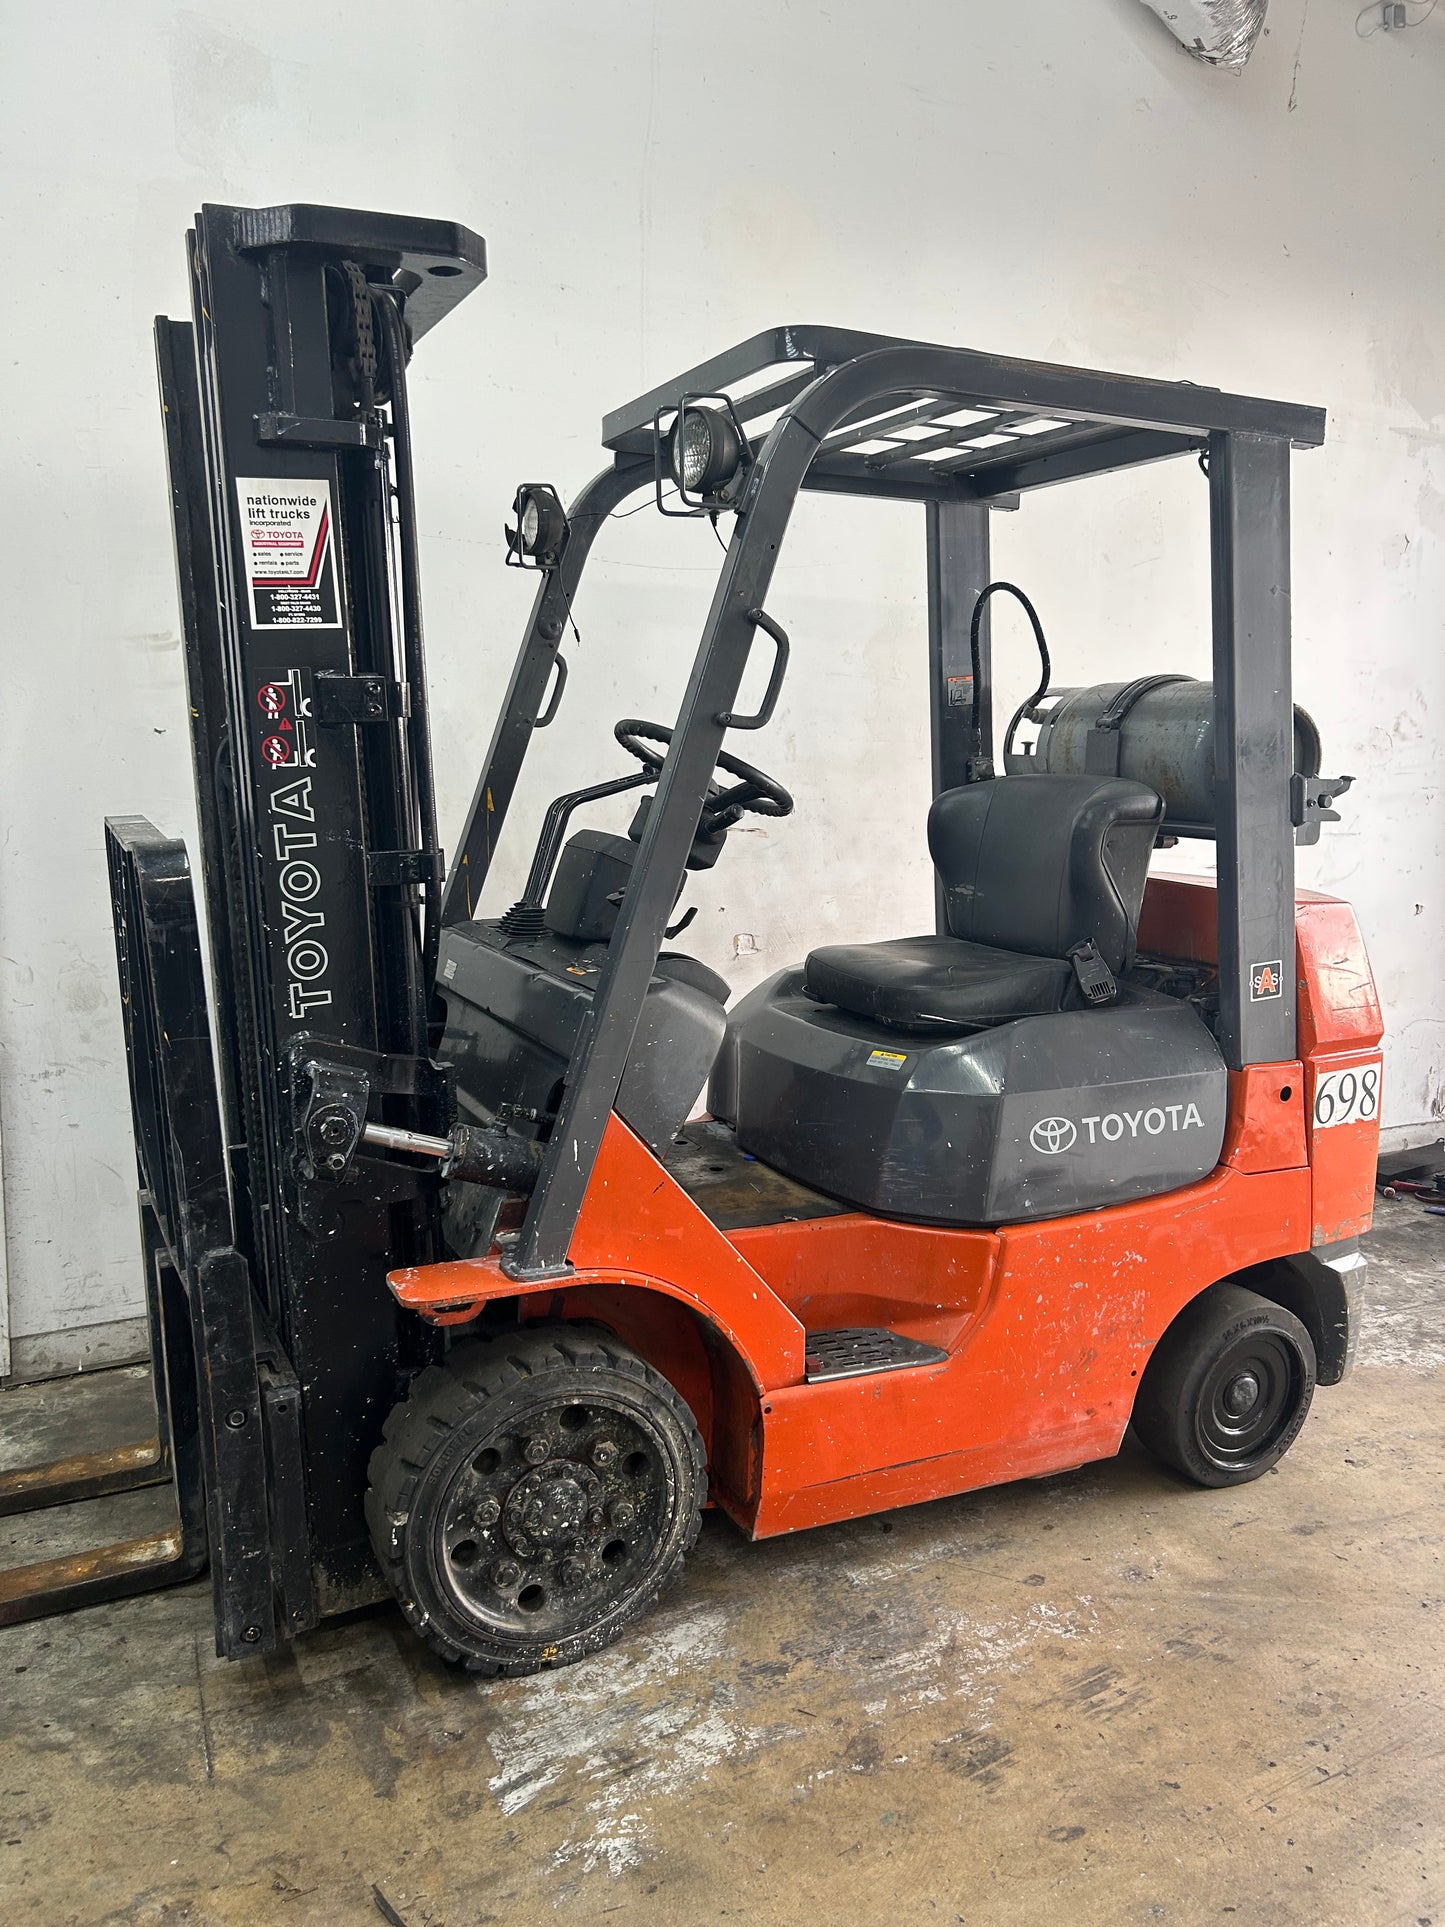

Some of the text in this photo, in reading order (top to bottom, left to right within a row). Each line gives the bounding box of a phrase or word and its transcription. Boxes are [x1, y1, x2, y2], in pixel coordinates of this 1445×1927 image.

[246, 494, 317, 506] nationwide
[247, 507, 311, 519] lift trucks
[267, 531, 304, 539] TOYOTA
[270, 775, 333, 1019] TOYOTA
[1314, 1069, 1378, 1126] 698
[1081, 1102, 1206, 1144] TOYOTA
